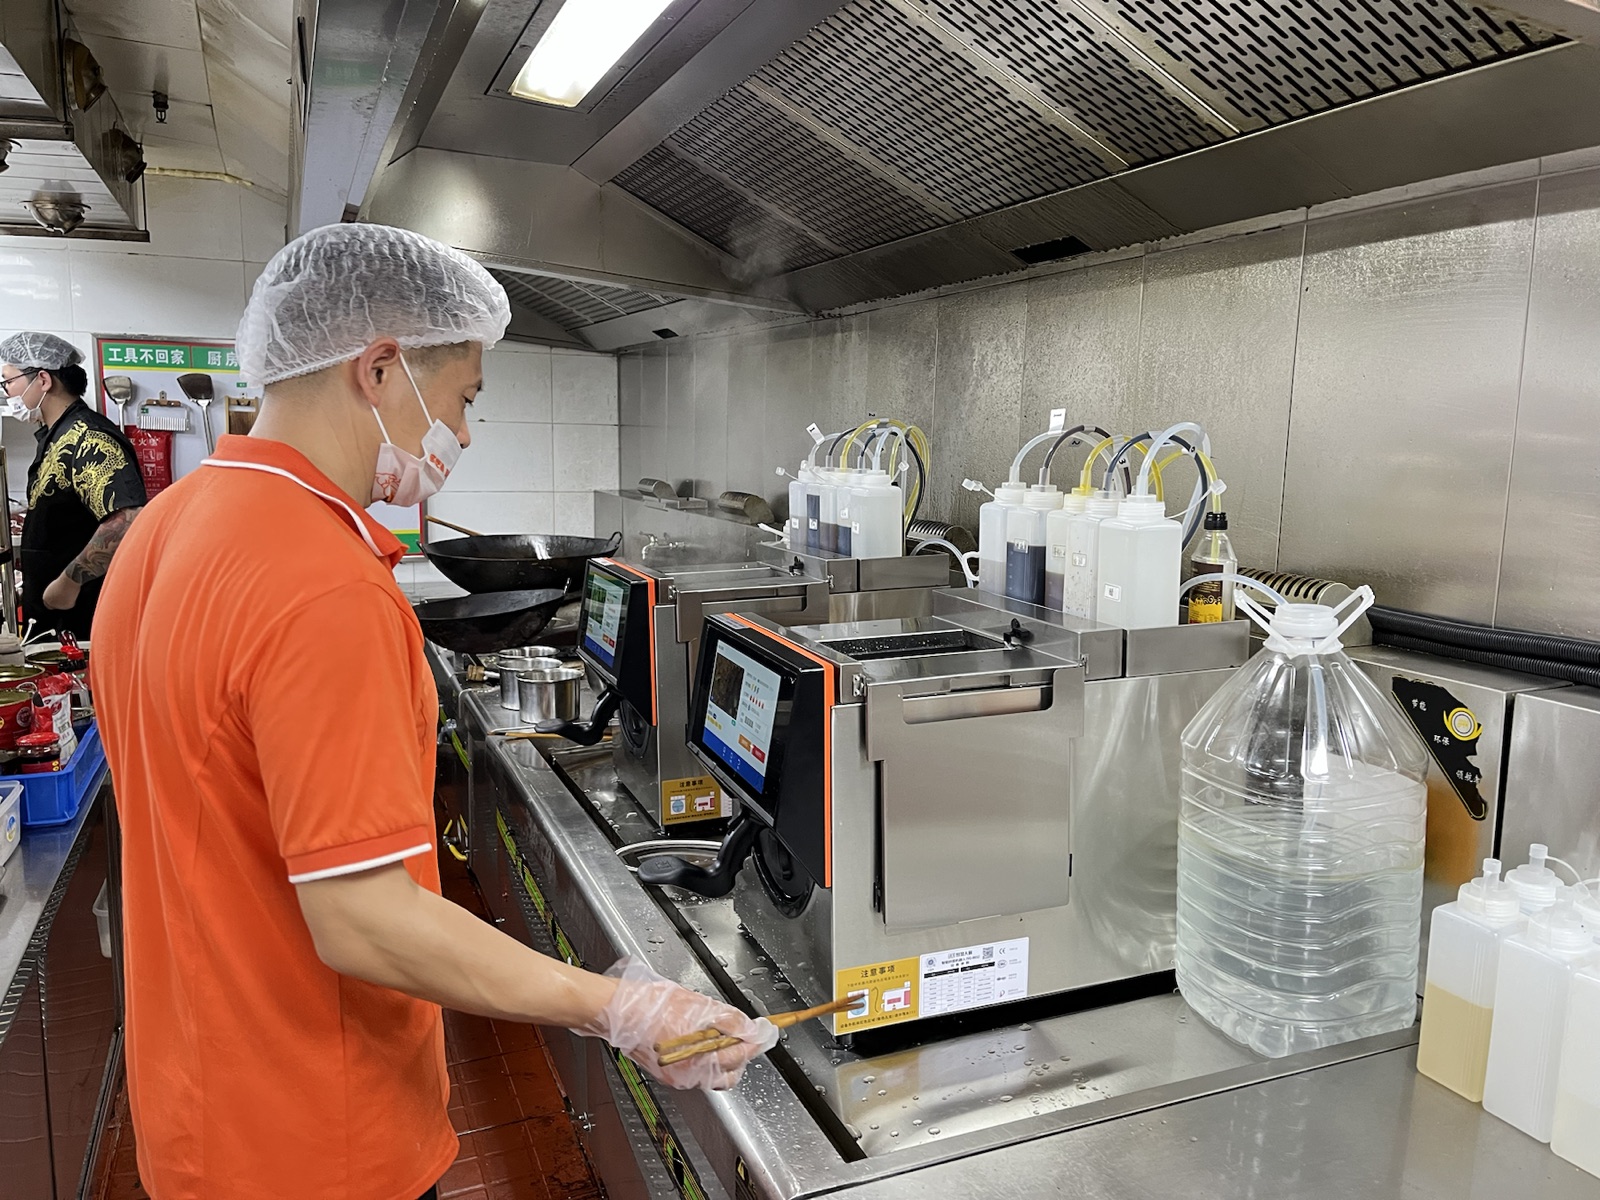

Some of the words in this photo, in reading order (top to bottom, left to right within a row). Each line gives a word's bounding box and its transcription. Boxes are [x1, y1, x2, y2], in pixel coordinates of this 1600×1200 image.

[108, 348, 185, 365] 工具不回家
[1433, 734, 1450, 746] 环保
[861, 965, 896, 978] 注意事项
